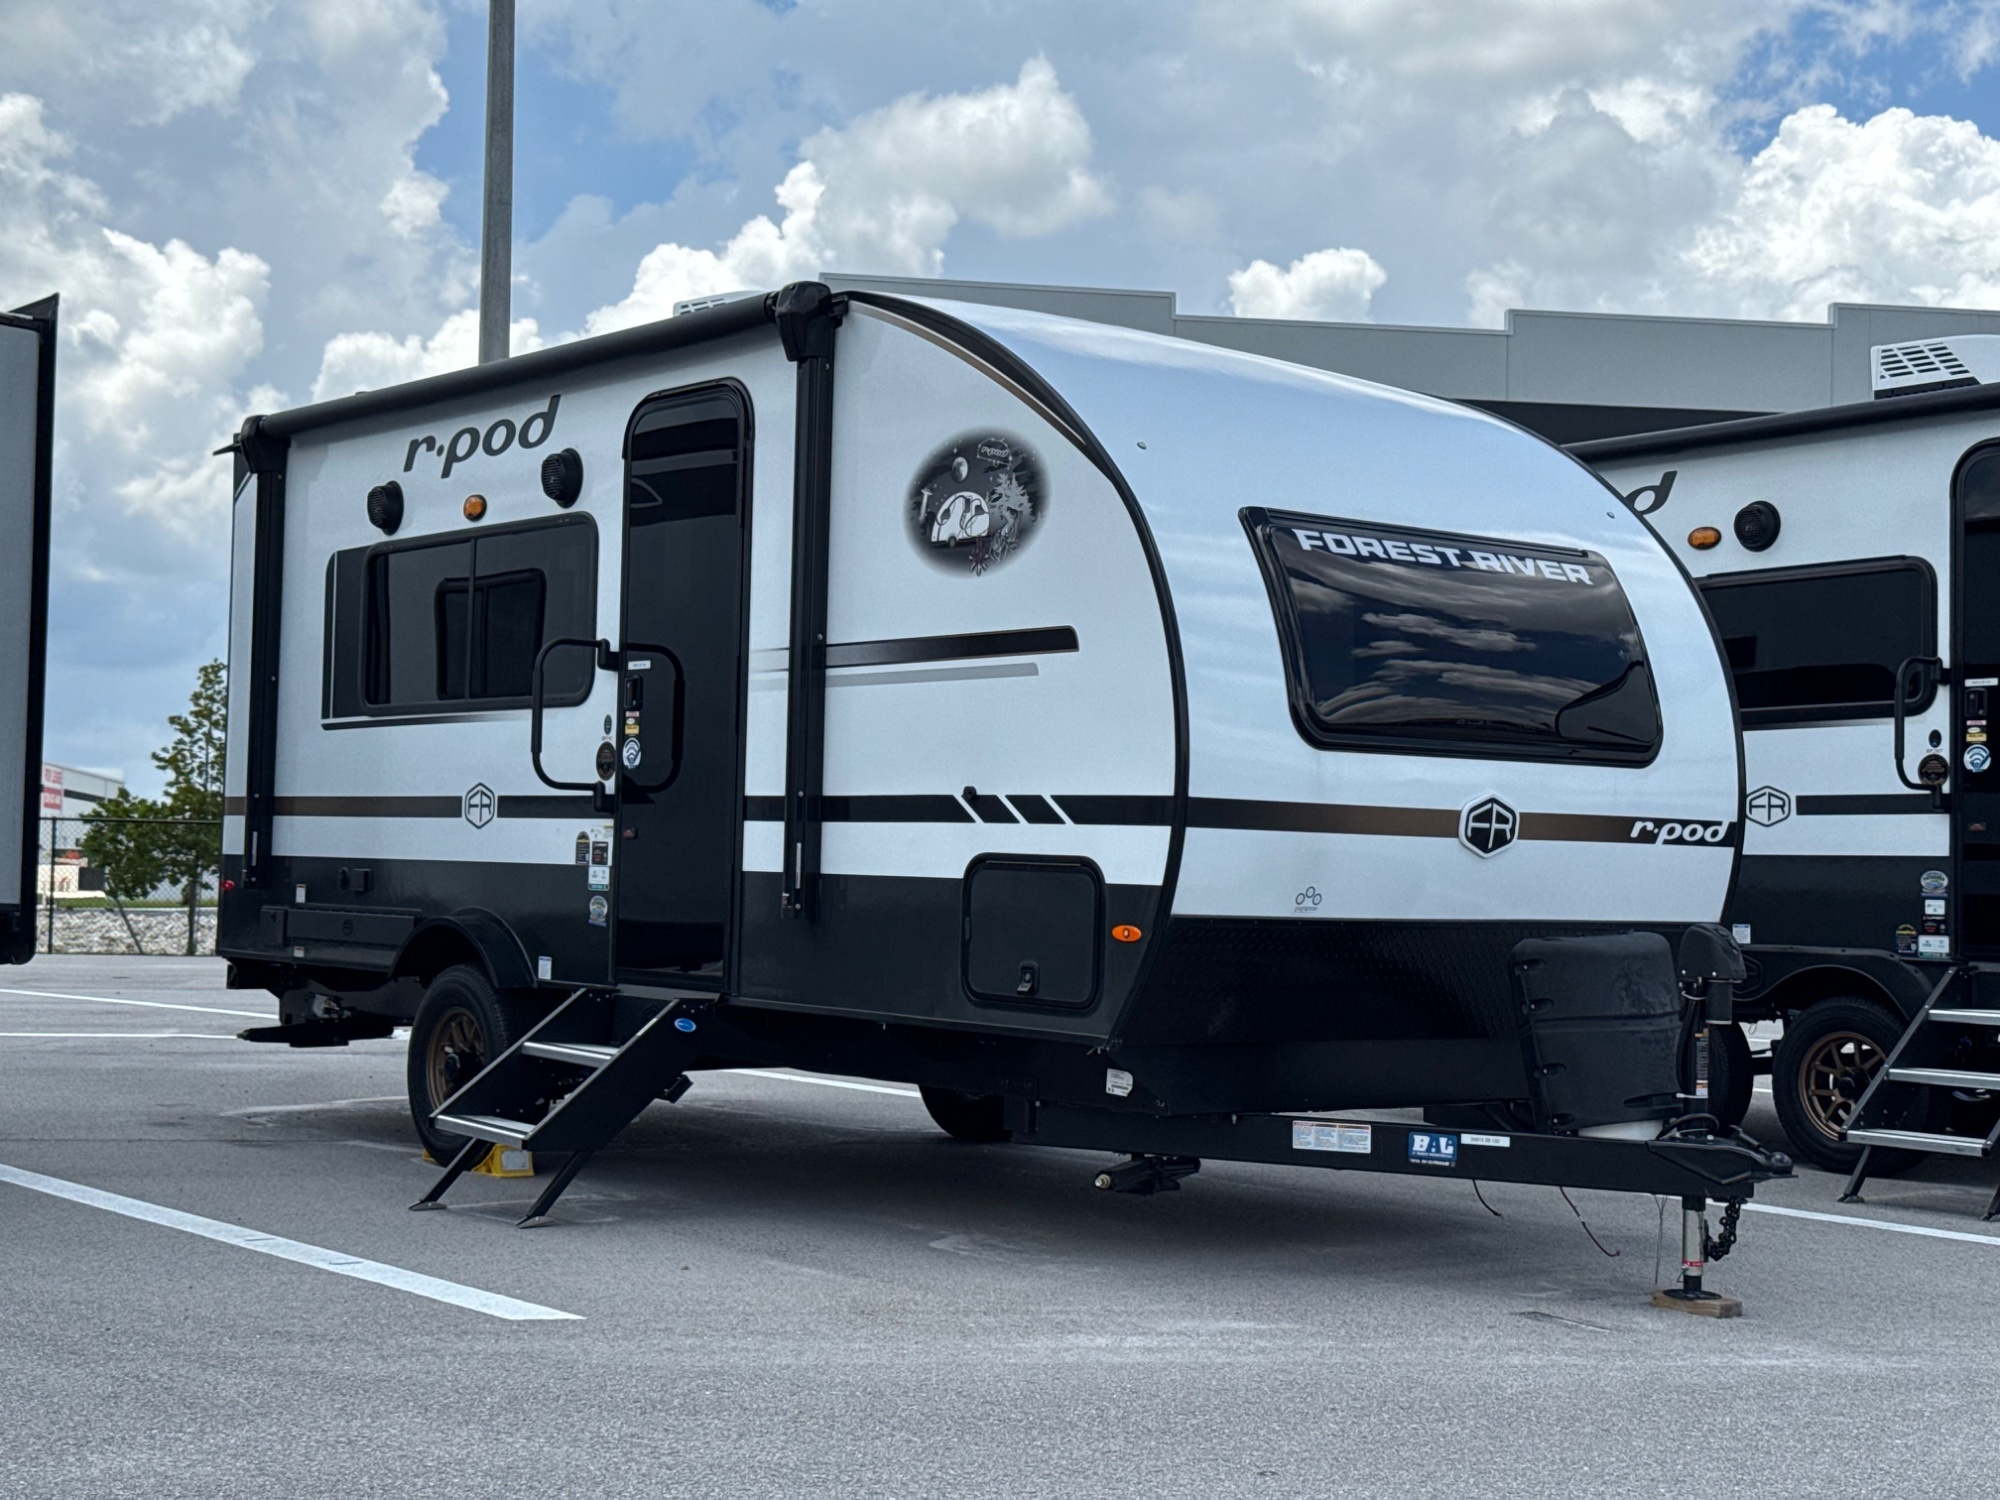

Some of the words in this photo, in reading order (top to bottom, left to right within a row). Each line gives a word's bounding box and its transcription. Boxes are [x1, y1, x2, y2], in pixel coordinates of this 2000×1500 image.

[1291, 528, 1462, 567] FOREST
[1468, 550, 1594, 586] RIVER
[1412, 1134, 1454, 1154] BAL
